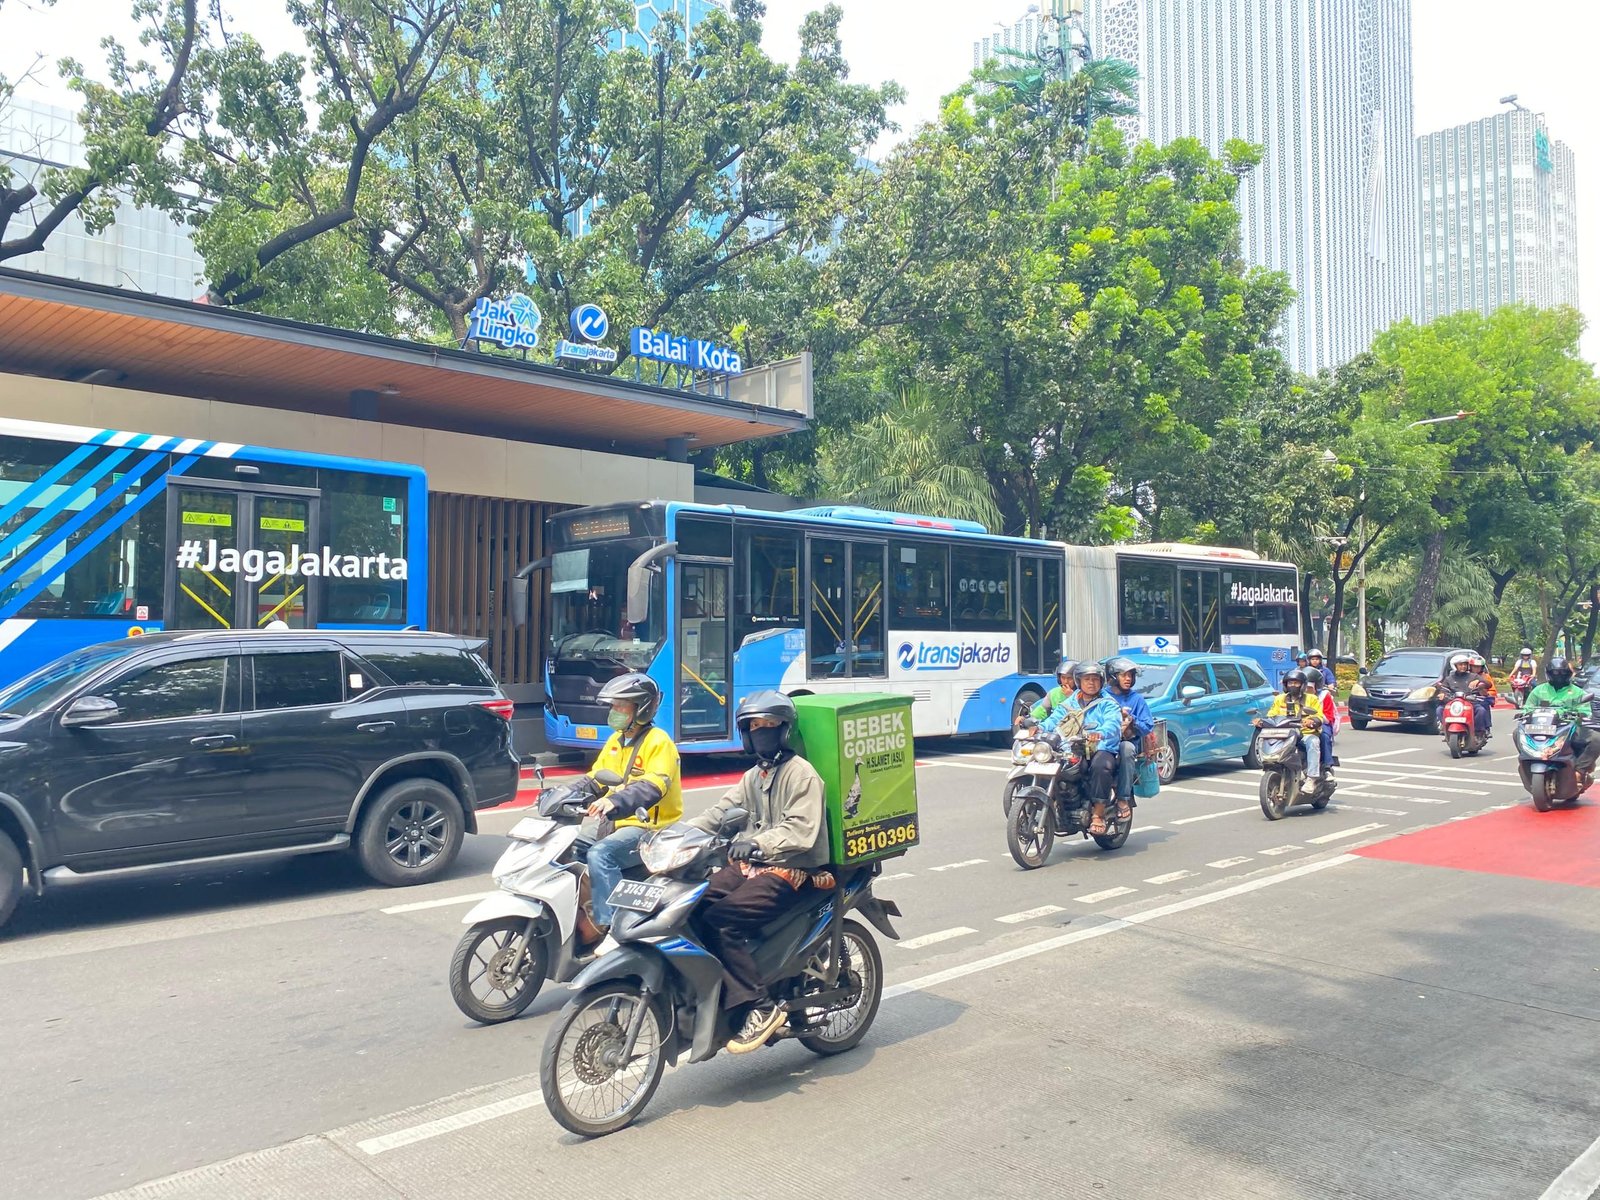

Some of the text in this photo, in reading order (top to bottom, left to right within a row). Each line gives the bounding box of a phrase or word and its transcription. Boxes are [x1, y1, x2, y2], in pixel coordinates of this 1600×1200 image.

[480, 300, 510, 319] Jak
[479, 318, 536, 346] Lingko
[563, 341, 616, 360] transjakarta
[639, 328, 741, 373] Balai Kota
[175, 538, 408, 582] #JagaJakarta
[1230, 581, 1294, 606] #JagaJakarta
[917, 641, 1011, 670] transjakarta
[843, 711, 905, 741] BEBEK
[844, 732, 906, 759] GORENG
[847, 823, 916, 857] 3810396
